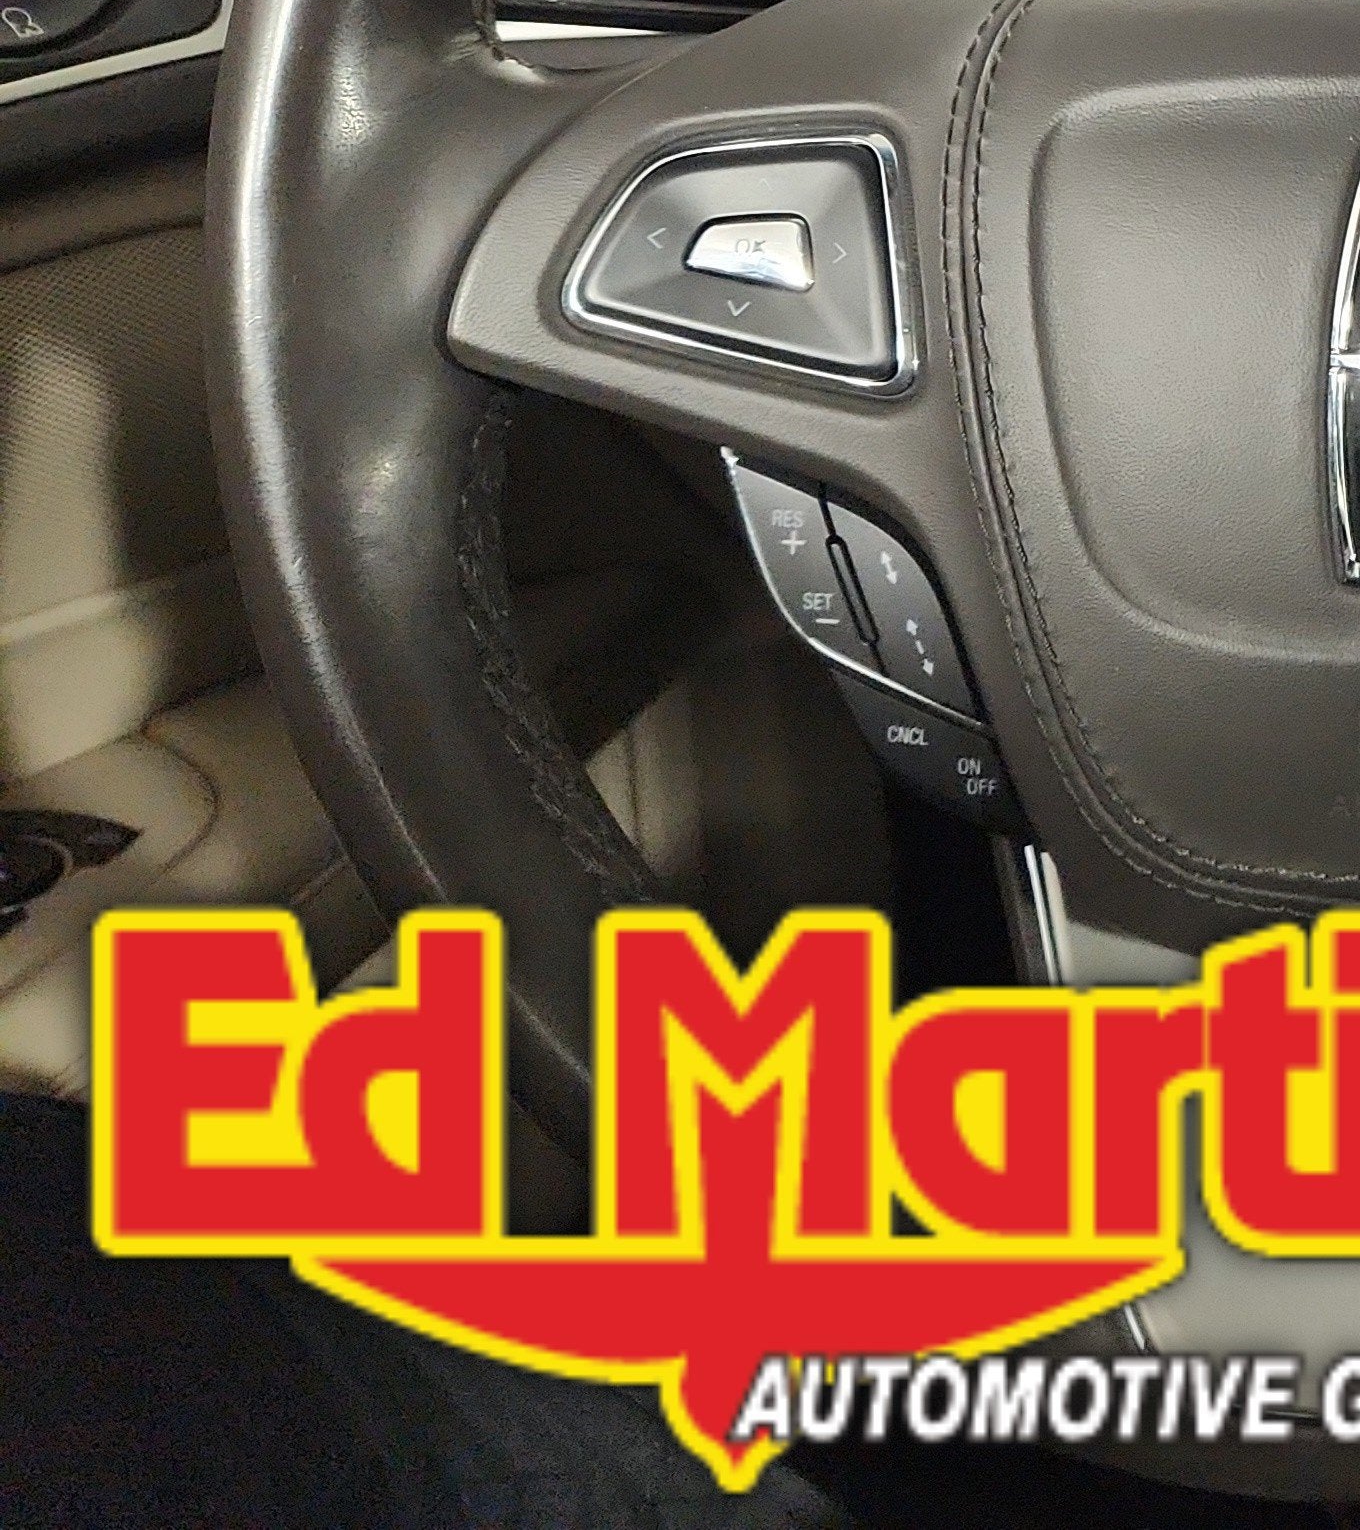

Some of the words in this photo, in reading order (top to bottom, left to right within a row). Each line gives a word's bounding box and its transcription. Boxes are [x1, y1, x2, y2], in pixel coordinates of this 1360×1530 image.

[771, 509, 804, 529] RES
[802, 591, 833, 610] SET
[957, 757, 981, 776] ON
[966, 778, 998, 795] OFF
